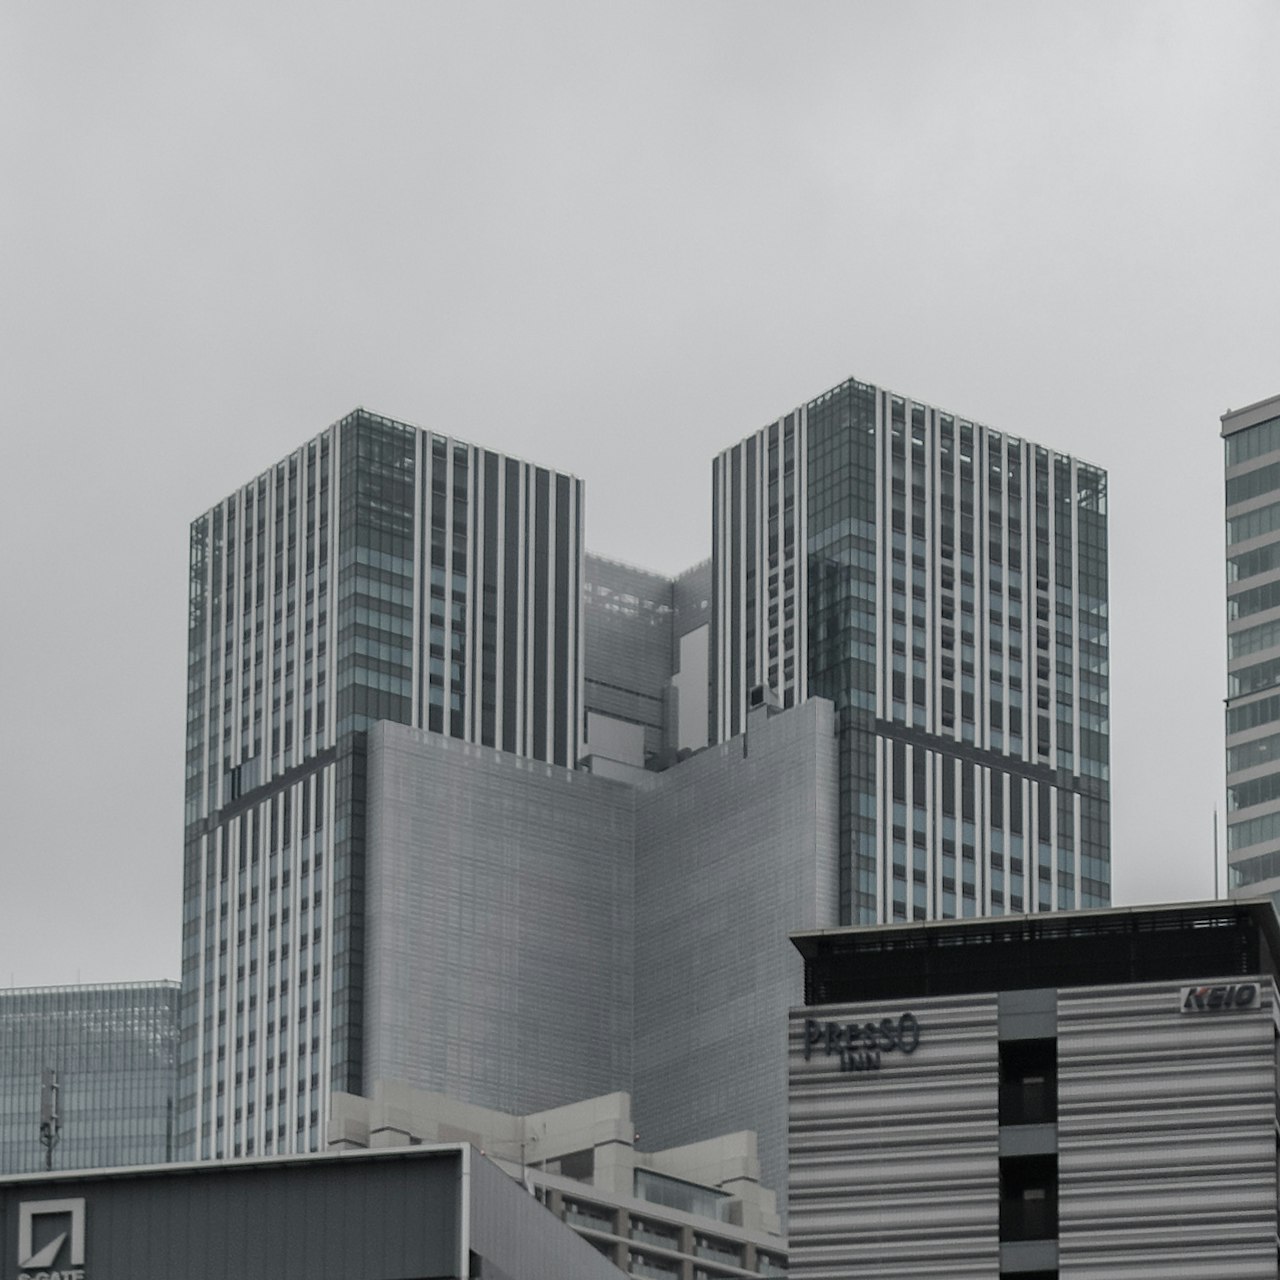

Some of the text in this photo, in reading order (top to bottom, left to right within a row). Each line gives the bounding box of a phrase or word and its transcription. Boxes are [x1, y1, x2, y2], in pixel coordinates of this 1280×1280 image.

[1184, 985, 1256, 1009] KEIO
[804, 1013, 920, 1062] PRESSO
[840, 1051, 880, 1072] INN
